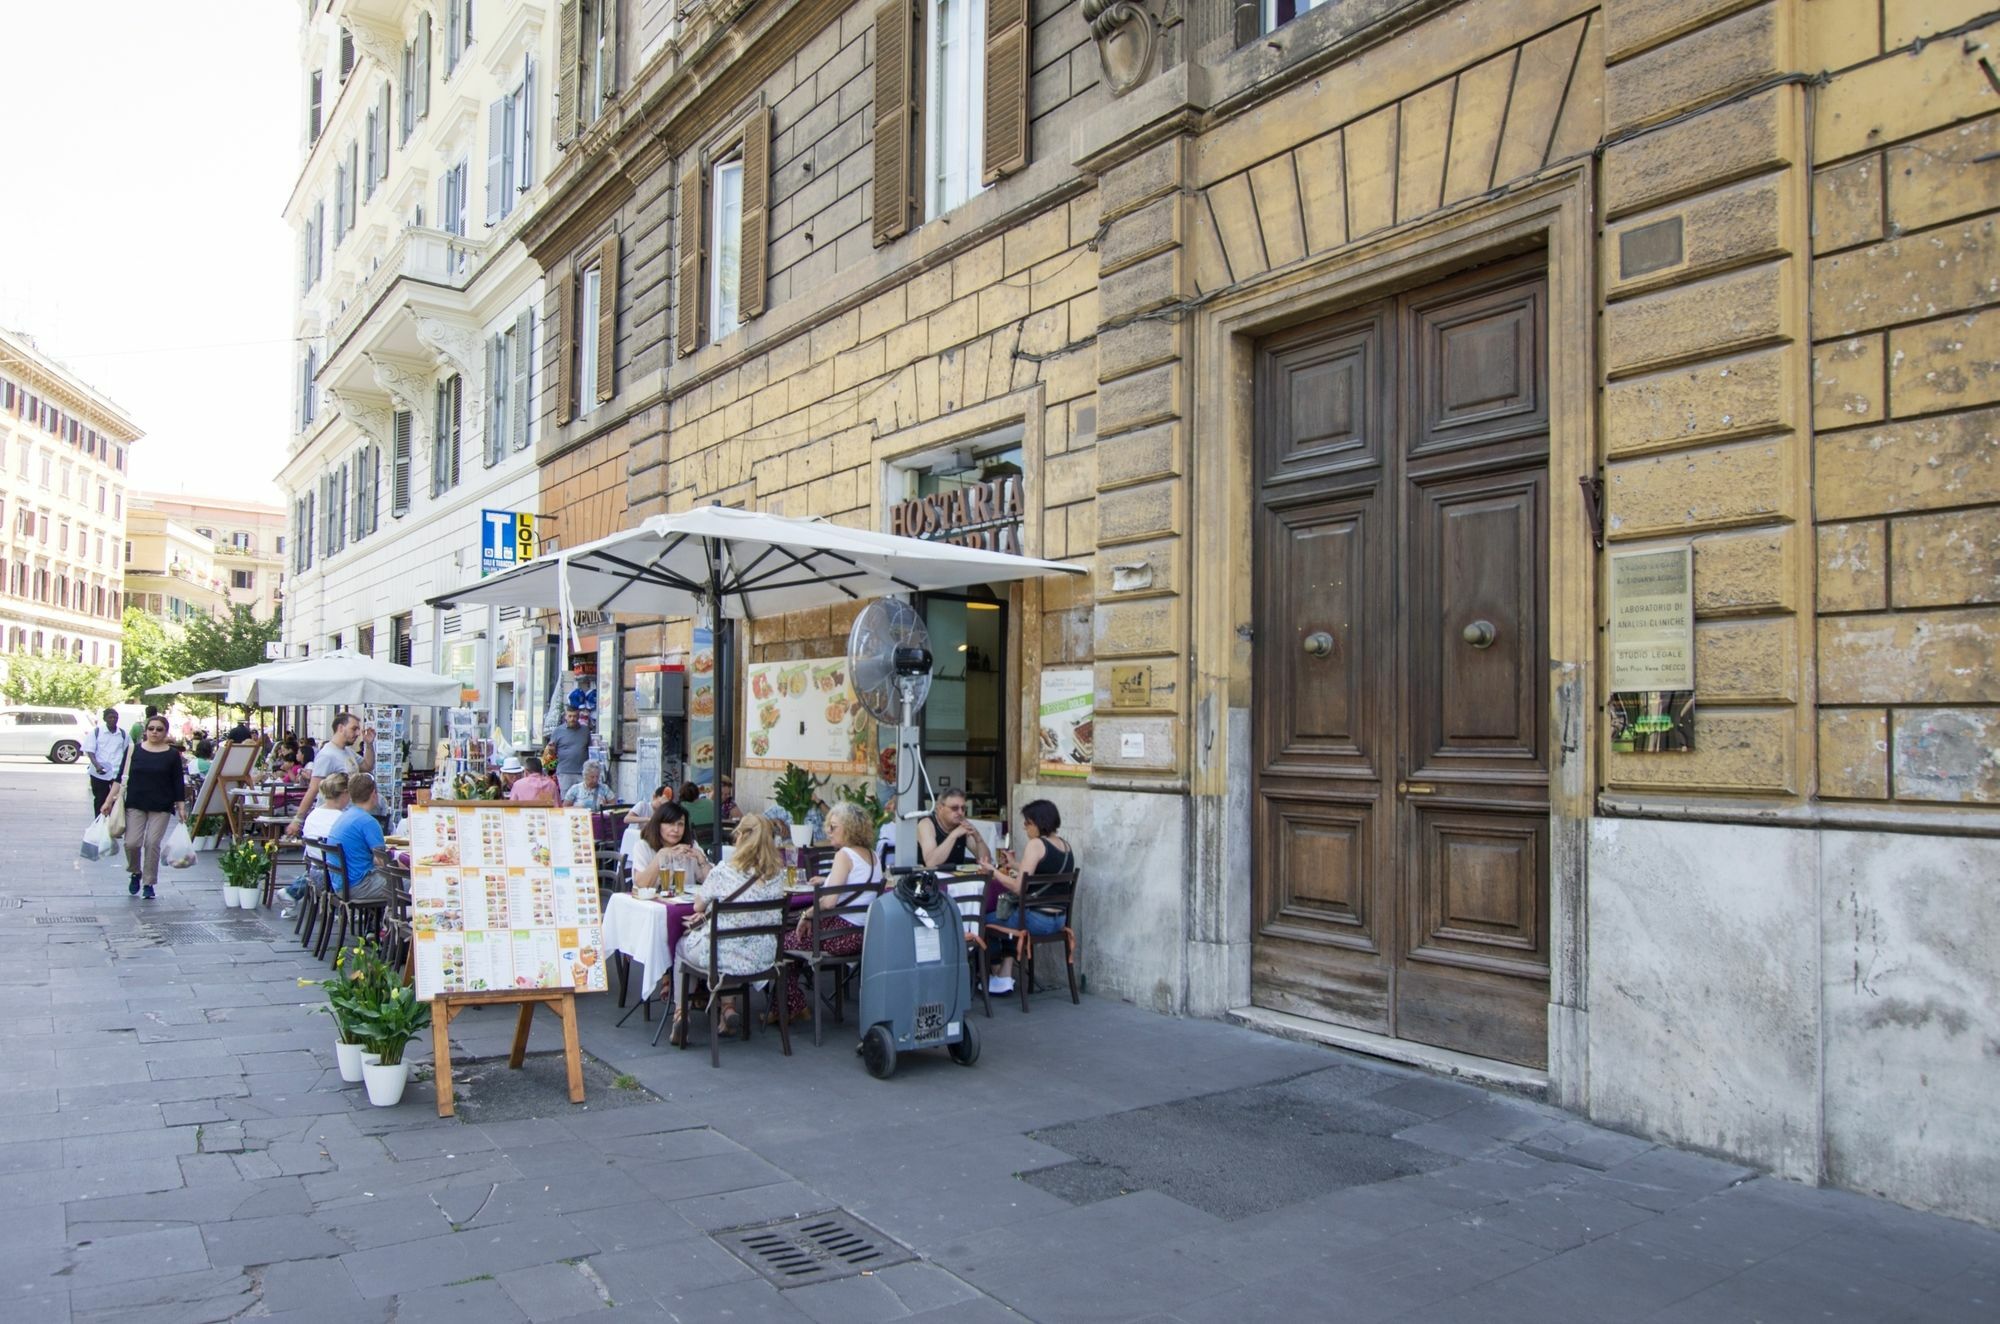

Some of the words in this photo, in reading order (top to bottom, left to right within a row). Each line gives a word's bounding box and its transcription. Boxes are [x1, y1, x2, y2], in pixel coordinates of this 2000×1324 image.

[890, 474, 1024, 538] HOSTARIA
[486, 512, 511, 560] T
[1620, 603, 1672, 614] LABORATORIO
[1674, 602, 1683, 611] DI
[1617, 620, 1647, 629] ANALISI
[1649, 617, 1685, 627] CLINICHE
[1618, 650, 1648, 659] STUDIO
[1651, 650, 1683, 659] LEGALE
